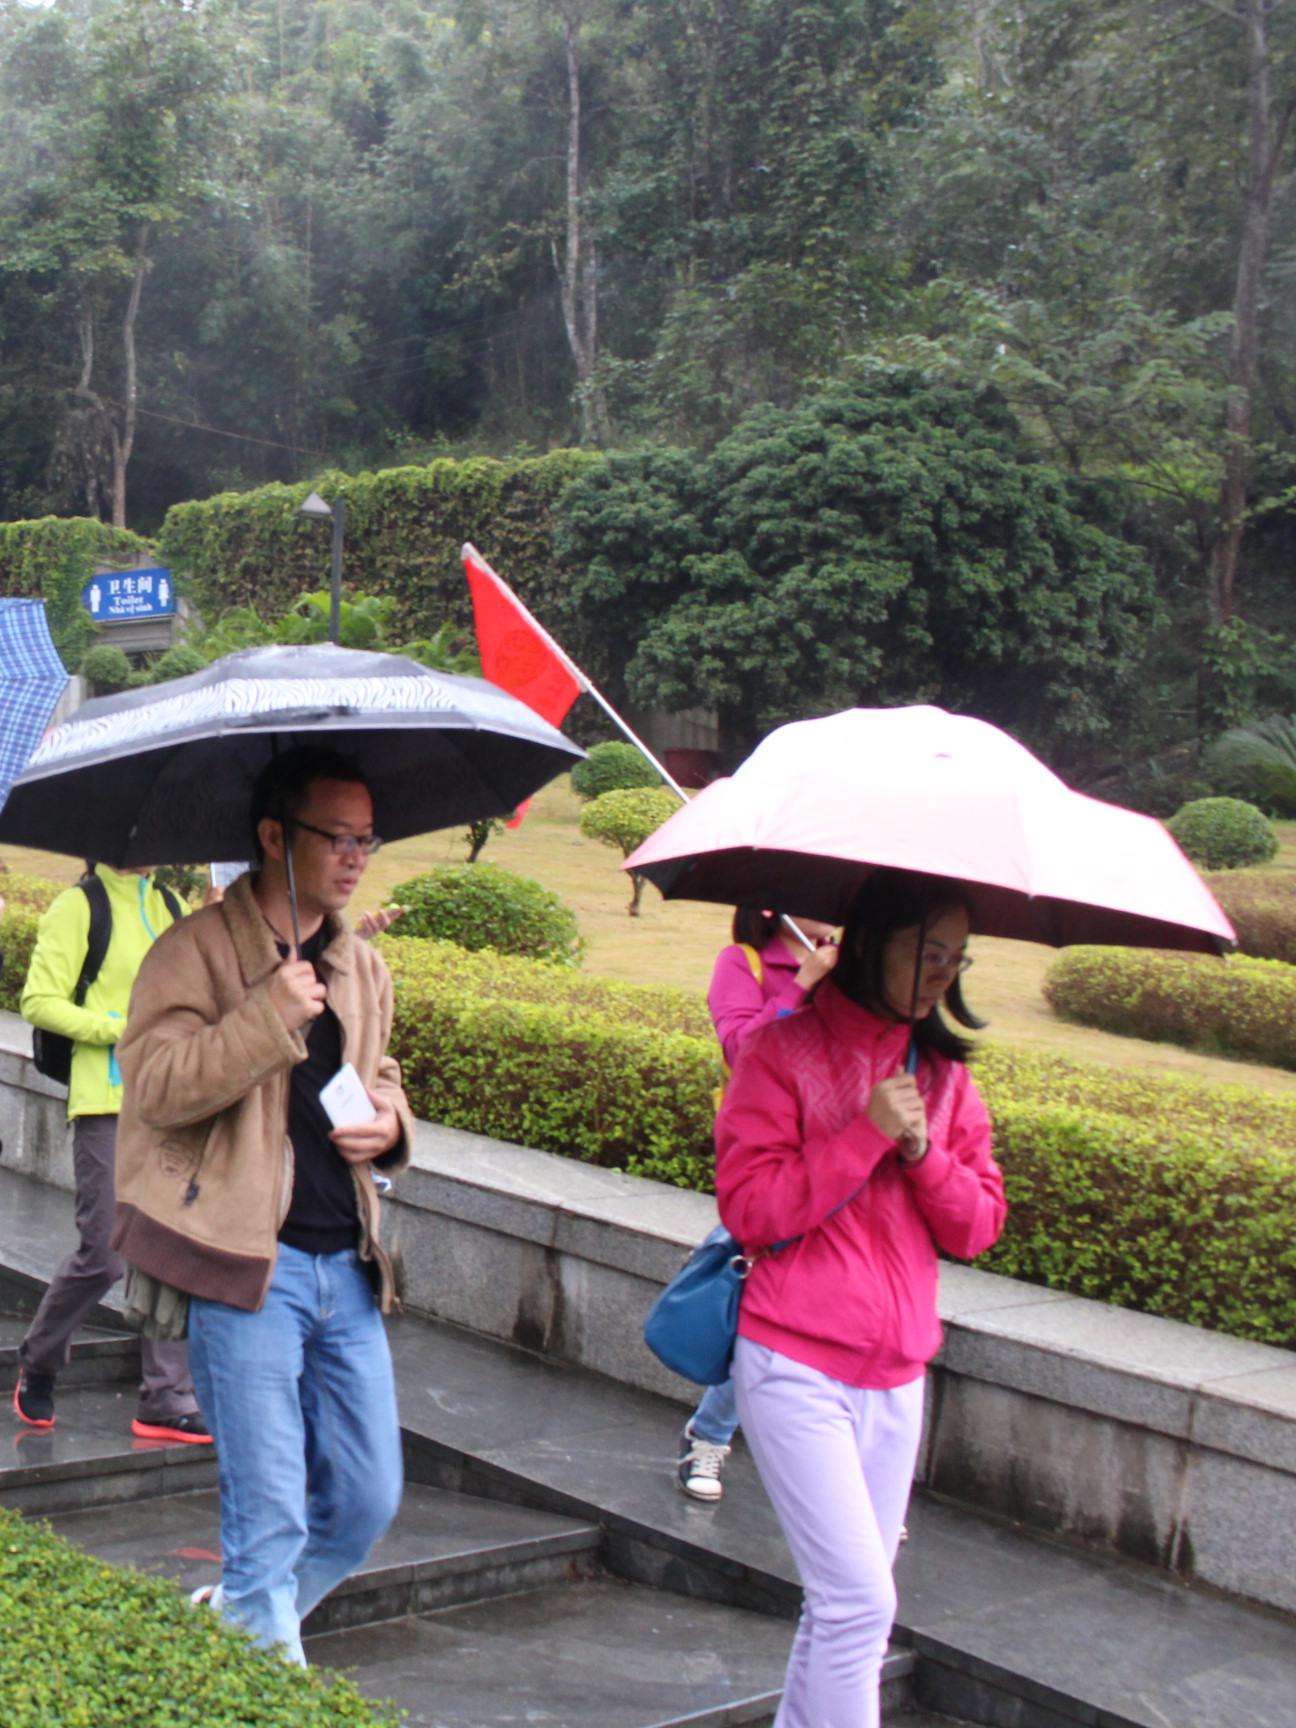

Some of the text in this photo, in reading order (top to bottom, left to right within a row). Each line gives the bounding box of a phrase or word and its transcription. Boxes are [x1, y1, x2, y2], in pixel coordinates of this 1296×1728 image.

[108, 576, 153, 594] 卫生间
[112, 595, 144, 606] Toilet
